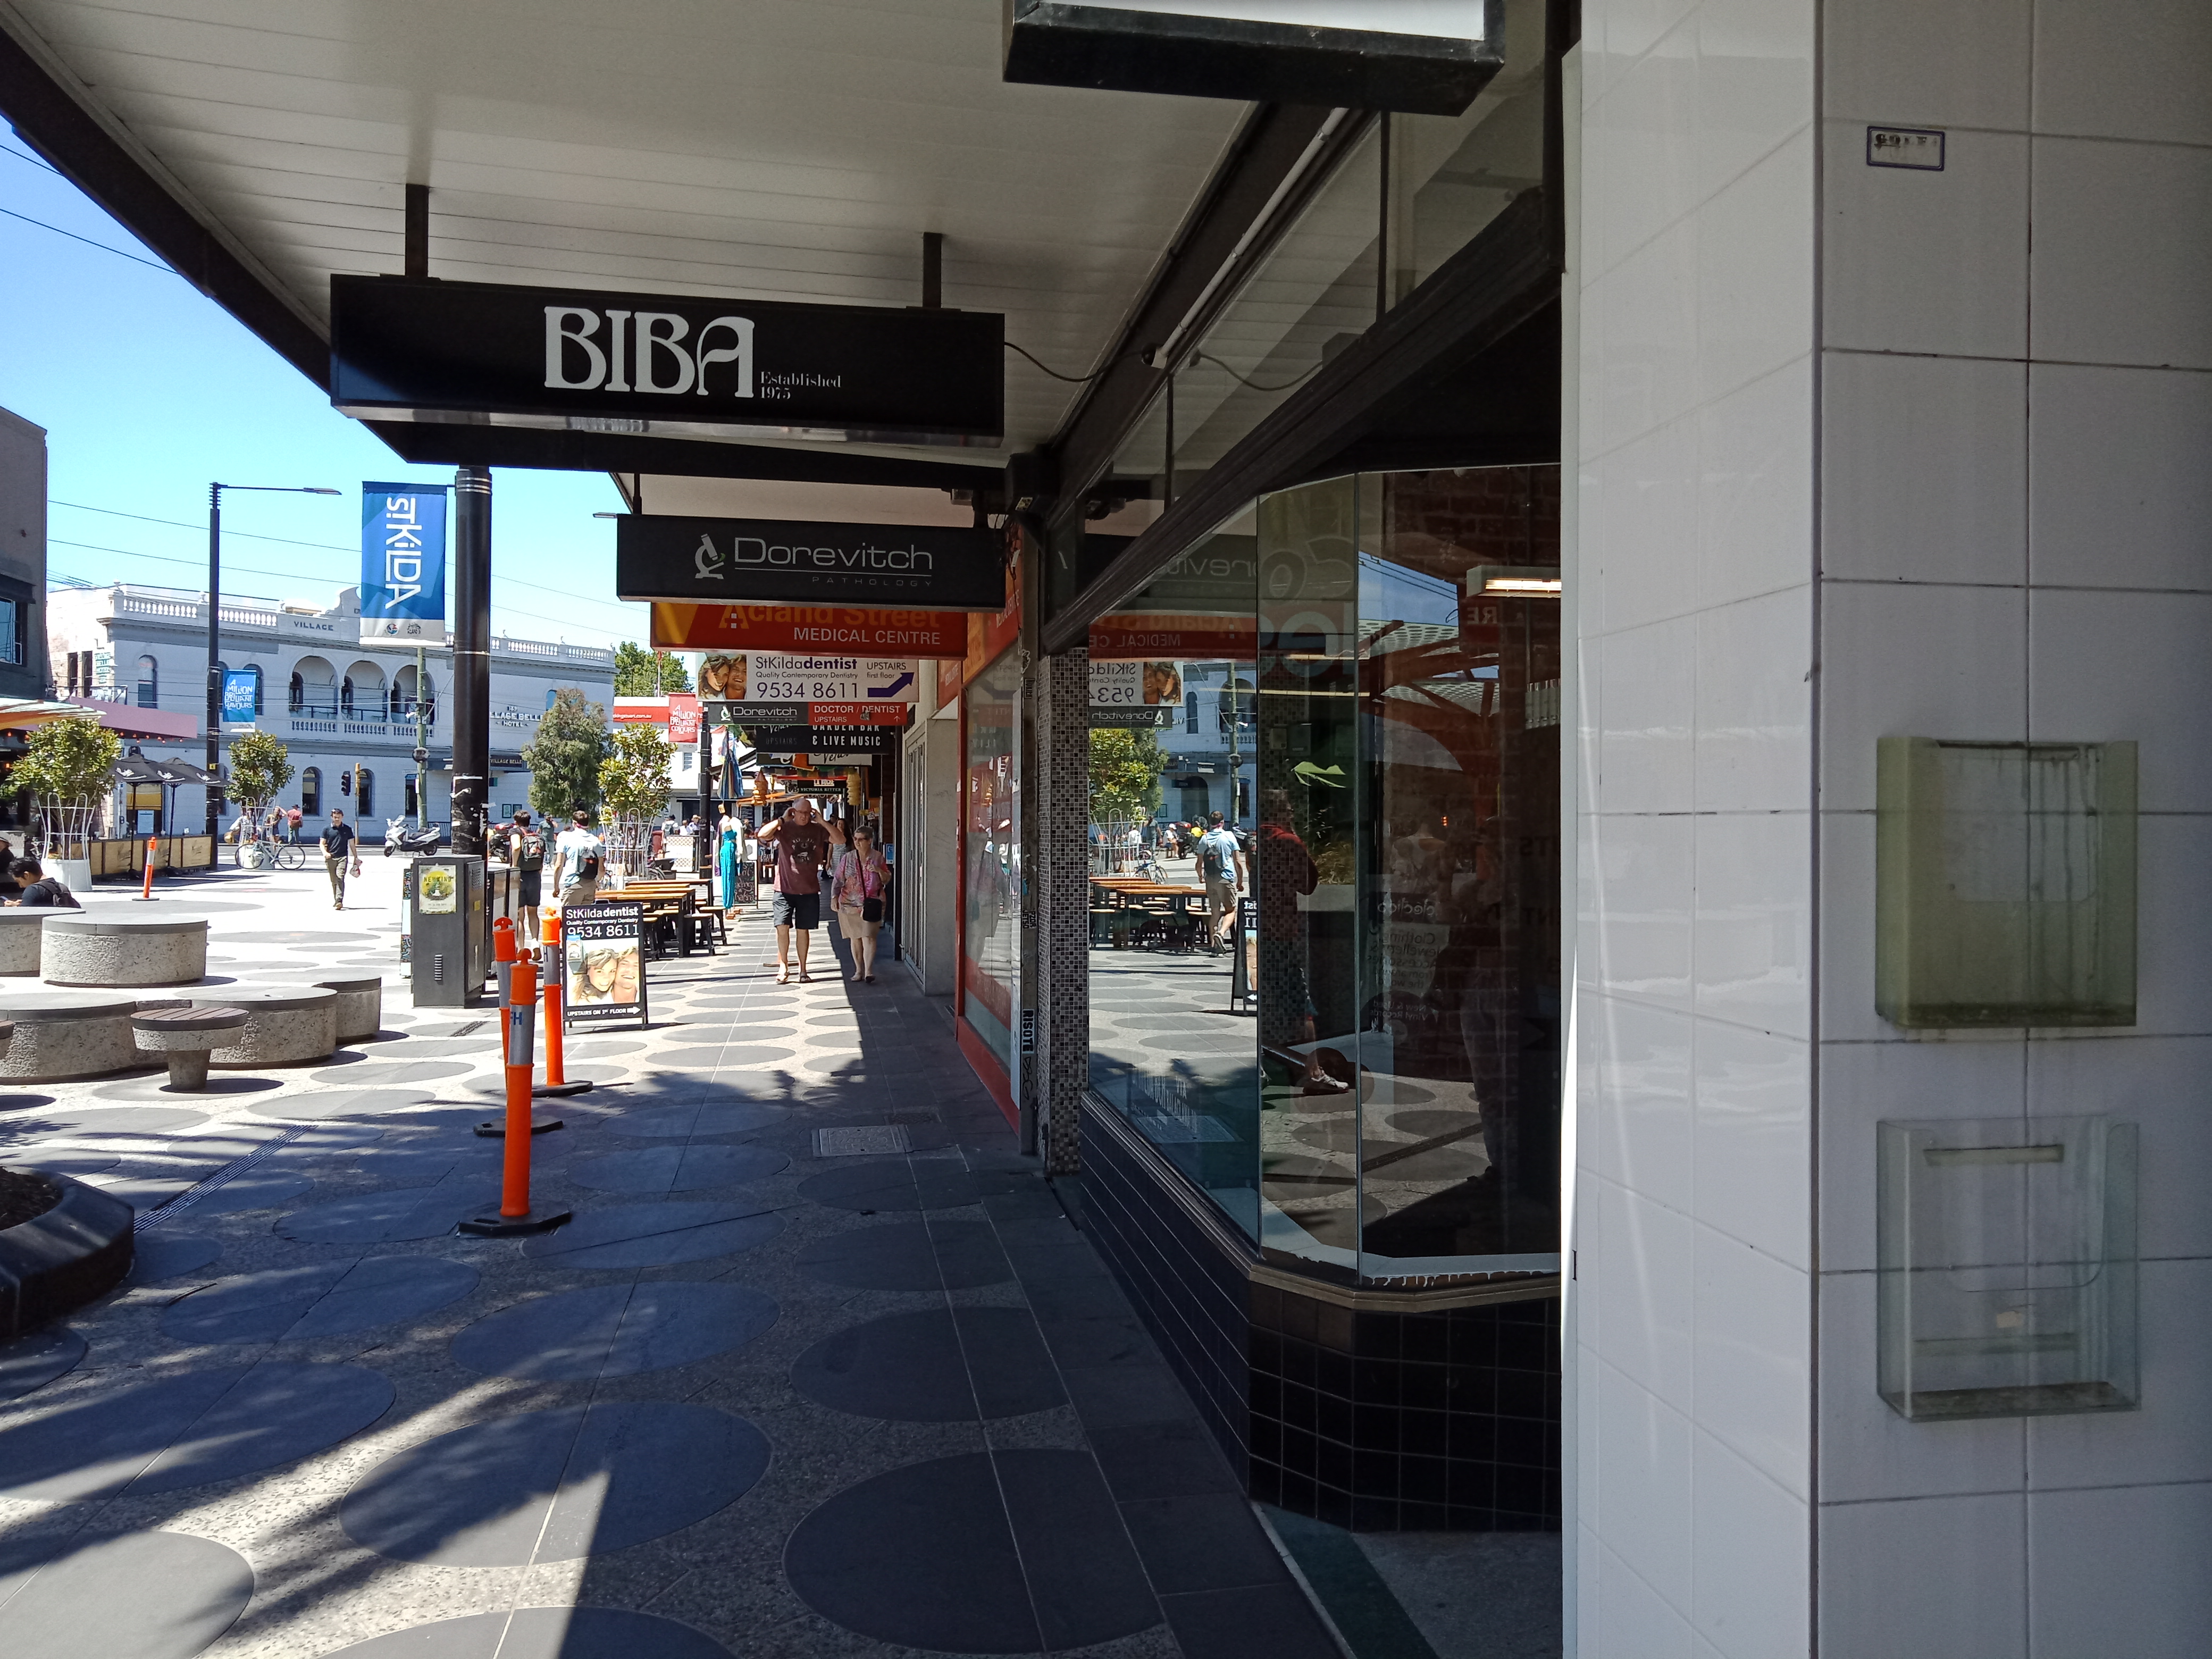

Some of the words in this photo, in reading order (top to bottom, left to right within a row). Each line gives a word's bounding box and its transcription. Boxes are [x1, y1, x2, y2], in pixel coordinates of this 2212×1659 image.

[544, 306, 755, 398] BIBA
[760, 372, 841, 388] Established
[760, 387, 791, 399] 1975
[735, 537, 933, 570] Dorevitch
[812, 577, 932, 587] PATHOLOGY
[294, 621, 333, 631] VILLAGE
[794, 627, 870, 643] MEDICAL
[875, 631, 941, 645] CENTRE
[757, 682, 806, 698] 9534
[813, 682, 858, 698] 8611
[733, 706, 798, 716] Dorevitch
[862, 705, 901, 714] DENTIST
[671, 725, 696, 734] COLOURS
[824, 736, 845, 746] LIVE
[851, 736, 881, 746] MUSIC
[606, 924, 639, 936] 8611
